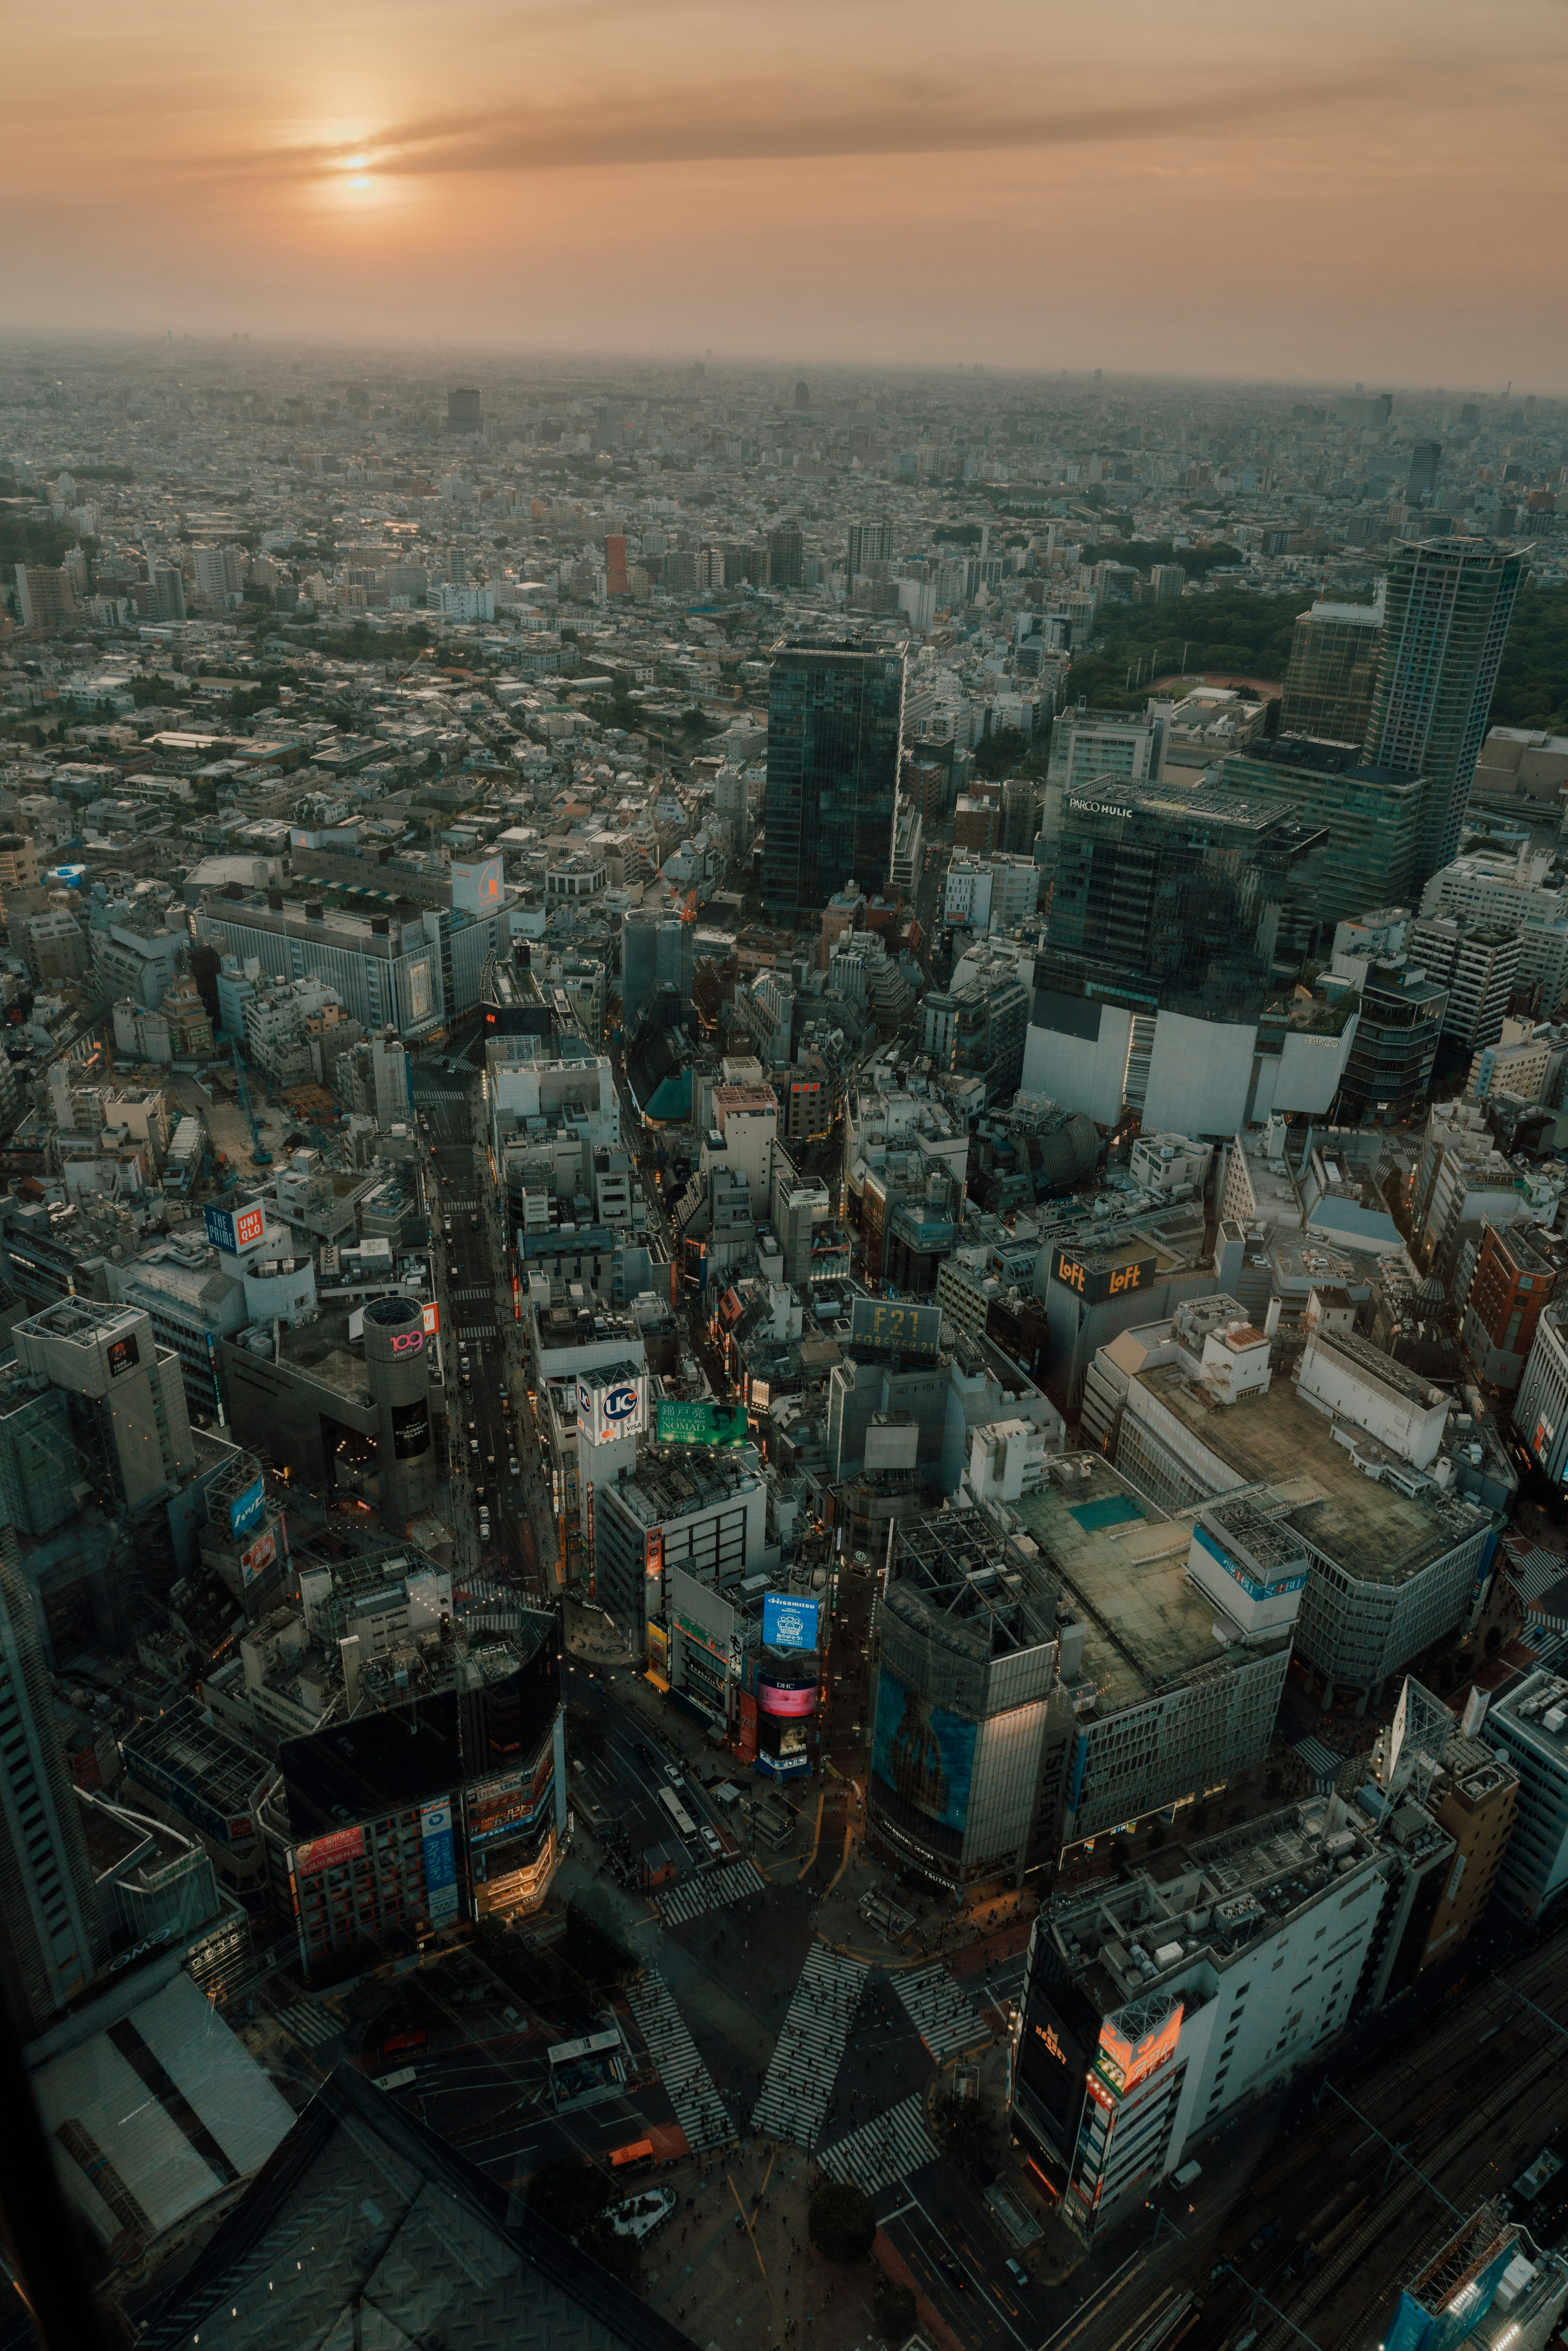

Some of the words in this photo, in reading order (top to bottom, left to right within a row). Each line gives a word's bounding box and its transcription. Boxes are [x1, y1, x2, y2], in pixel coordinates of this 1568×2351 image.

[1069, 798, 1100, 812] PARCO
[1101, 805, 1132, 818] HULIC
[478, 895, 504, 907] TOKYU
[486, 1014, 495, 1023] H&M
[1306, 1037, 1339, 1048] PARCO
[212, 1212, 227, 1231] THE
[240, 1214, 258, 1229] UNI
[209, 1225, 234, 1248] PRIME
[241, 1224, 260, 1241] QLO
[874, 1307, 918, 1337] F21
[390, 1330, 423, 1352] 109
[855, 1333, 916, 1351] FOREVER
[920, 1342, 934, 1354] 21
[394, 1348, 412, 1358] SHIBUYA
[114, 1359, 127, 1370] TOHO
[114, 1361, 132, 1374] CINEMAS
[662, 1404, 705, 1418] 錦戸亮
[626, 1422, 641, 1431] VISA
[662, 1421, 705, 1431] NOMAD
[1226, 1560, 1253, 1595] SEIBU
[1264, 1579, 1301, 1597] SEIBU
[768, 1597, 815, 1609] Hisamitsu
[690, 1663, 715, 1685] Euphoria
[780, 1743, 807, 1756] DMM
[1034, 1738, 1067, 1845] TSUTAYA
[426, 1823, 448, 1833] eyecity
[325, 1830, 358, 1845] 品川スキン
[326, 1837, 355, 1850] クリニック
[309, 1847, 360, 1870] 品川美容外科
[924, 1870, 955, 1890] TSUTAYA
[1099, 2035, 1125, 2068] アコム
[1131, 2039, 1174, 2081] アコム
[1140, 2066, 1157, 2082] 3F
